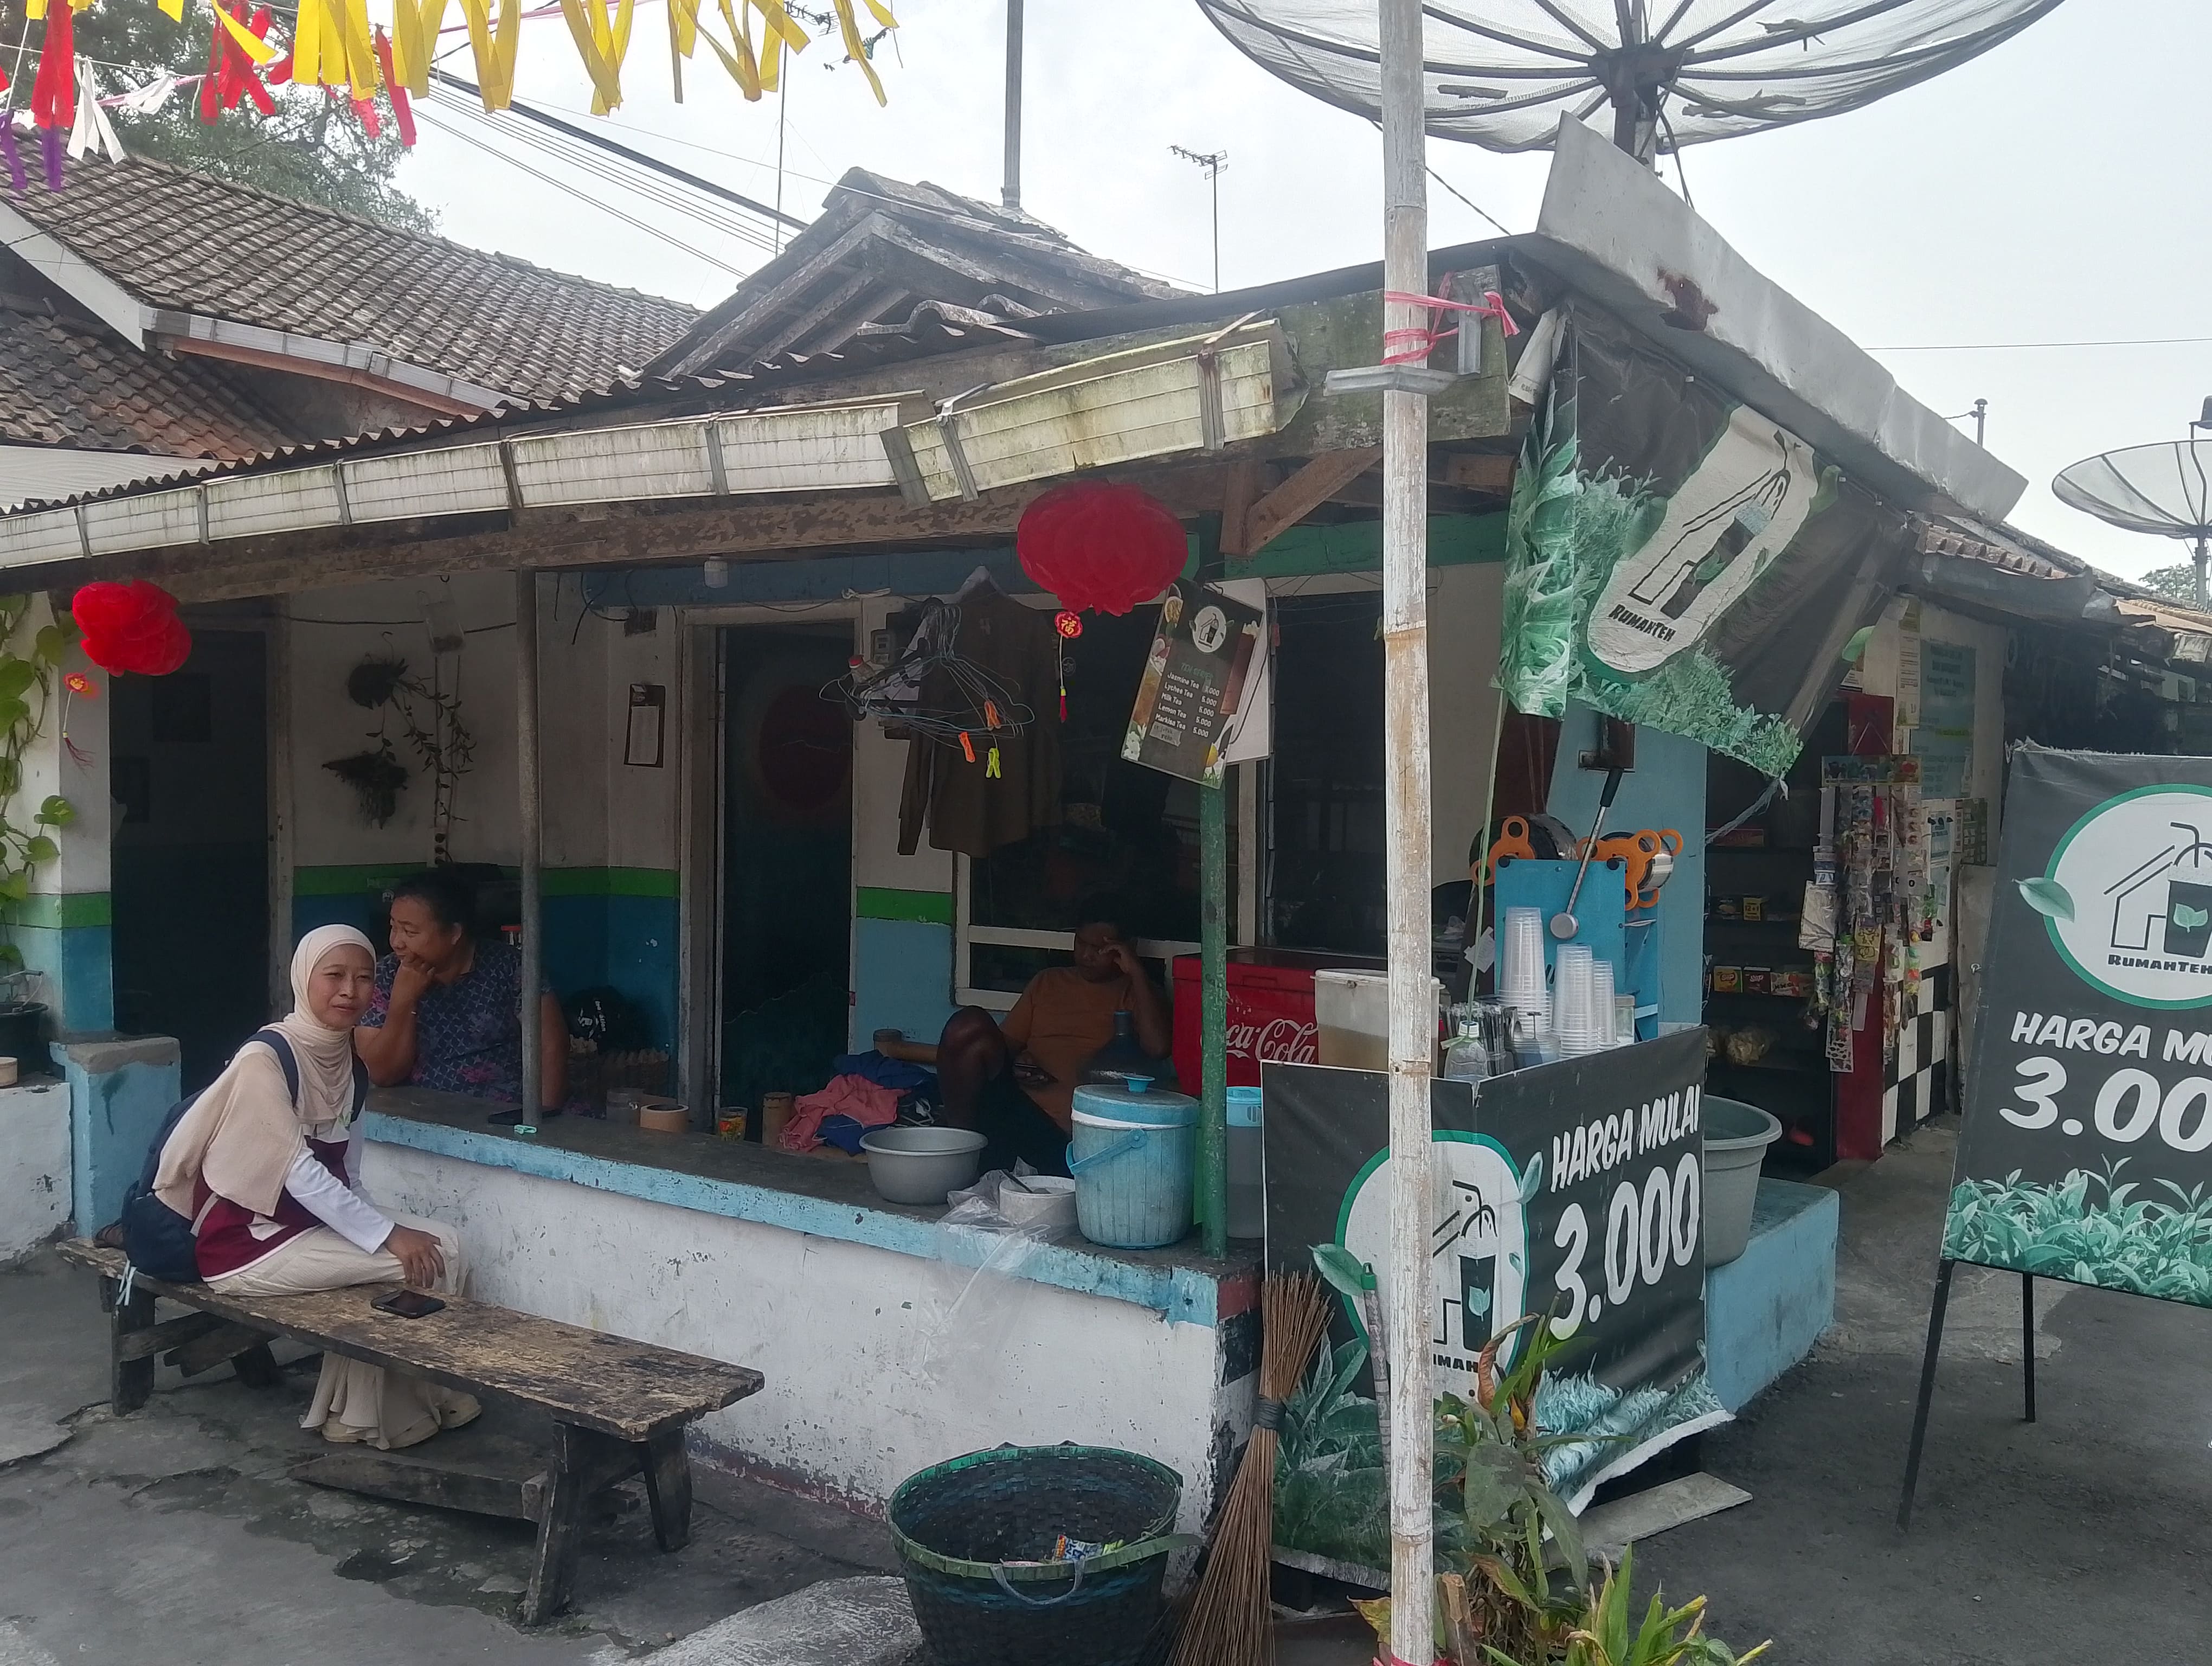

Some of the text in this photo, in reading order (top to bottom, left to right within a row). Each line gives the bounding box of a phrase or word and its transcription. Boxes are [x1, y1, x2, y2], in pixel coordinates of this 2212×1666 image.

[1167, 672, 1189, 685] Jasmine
[1190, 680, 1200, 689] Tea
[1161, 692, 1214, 717] Milk Tea 5.000
[1164, 681, 1217, 707] Lychee Tea 5.000
[1155, 713, 1176, 727] Markisa
[1176, 720, 1186, 730] Tea
[1193, 726, 1209, 738] 5.000
[1158, 702, 1212, 727] Lemon Tea 5.000
[2107, 954, 2212, 975] RUMAHTEH
[1200, 1018, 1319, 1065] ca-Cola
[2010, 1011, 2151, 1060] HARGA
[1550, 1083, 1701, 1193] HARGA MULAI
[1549, 1152, 1700, 1341] 3.000
